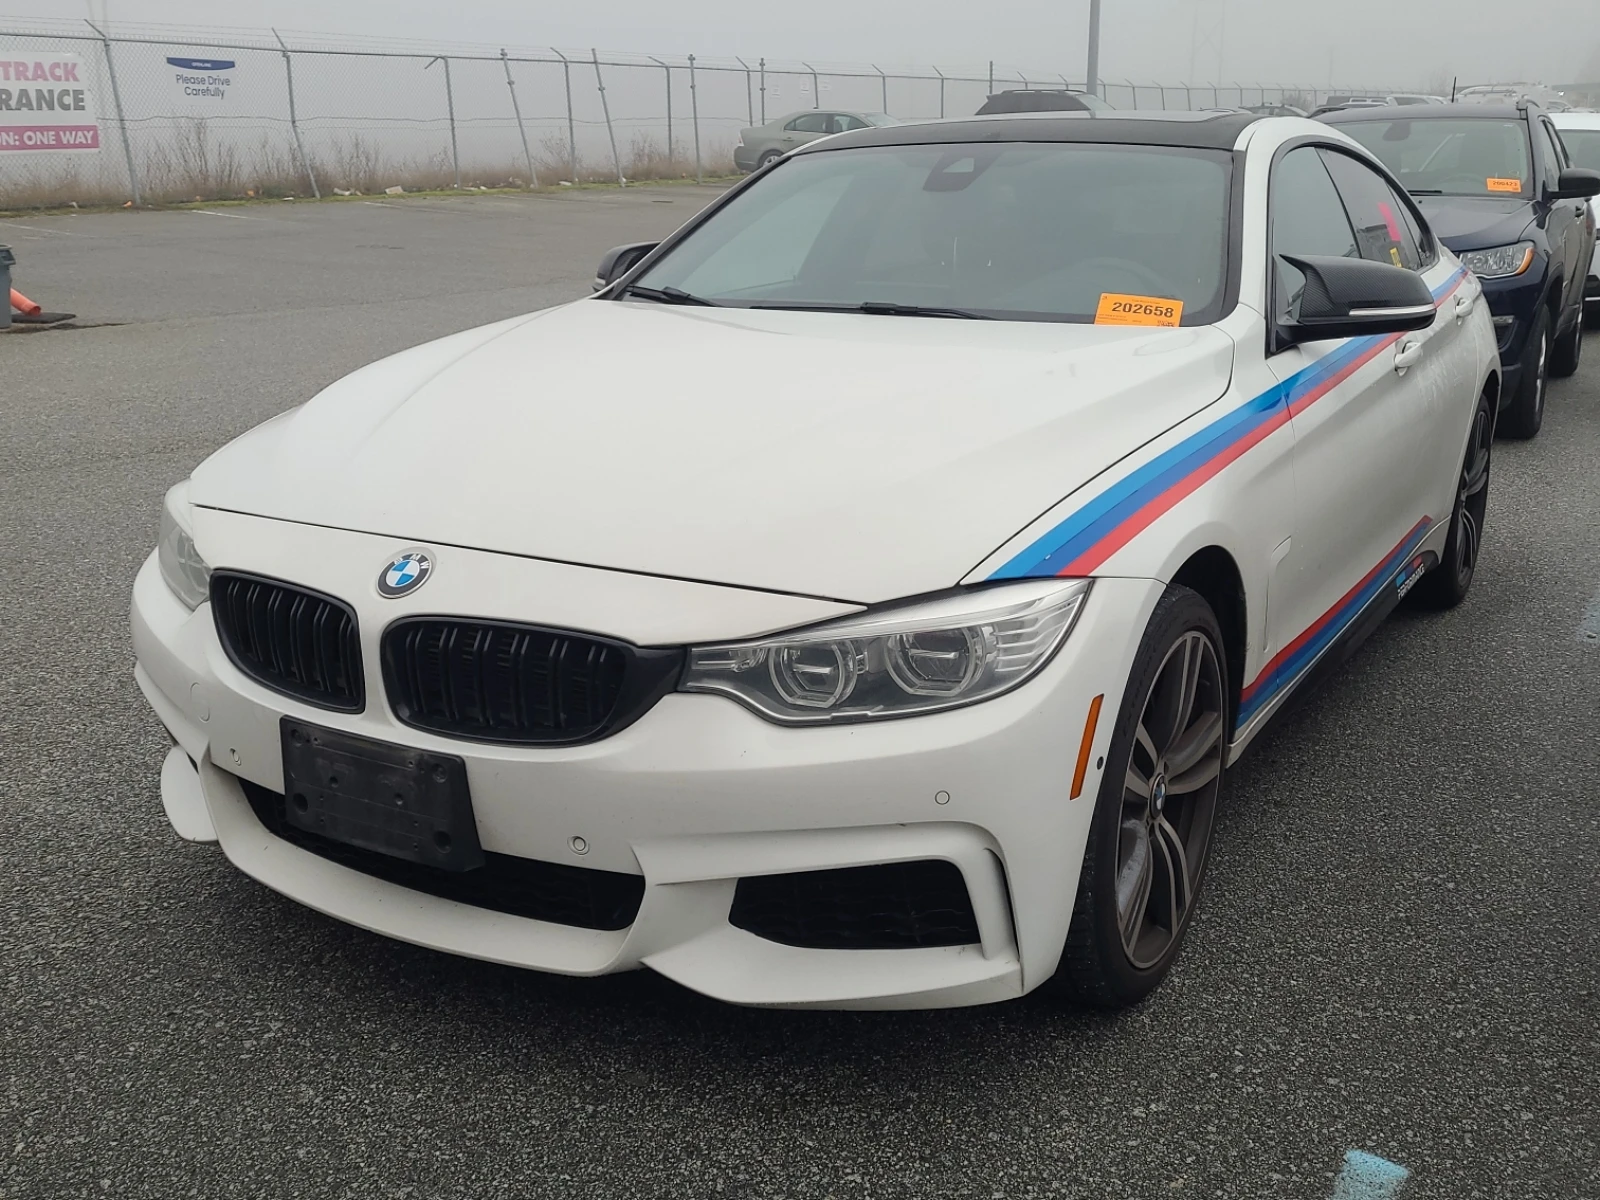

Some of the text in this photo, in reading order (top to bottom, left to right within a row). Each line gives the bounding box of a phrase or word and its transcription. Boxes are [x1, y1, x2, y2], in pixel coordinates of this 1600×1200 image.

[0, 61, 80, 82] TRACK
[176, 74, 231, 86] Please Drive
[184, 86, 225, 100] Carefully
[23, 131, 56, 145] ONE
[59, 130, 94, 144] WAY
[1111, 301, 1174, 318] 202658
